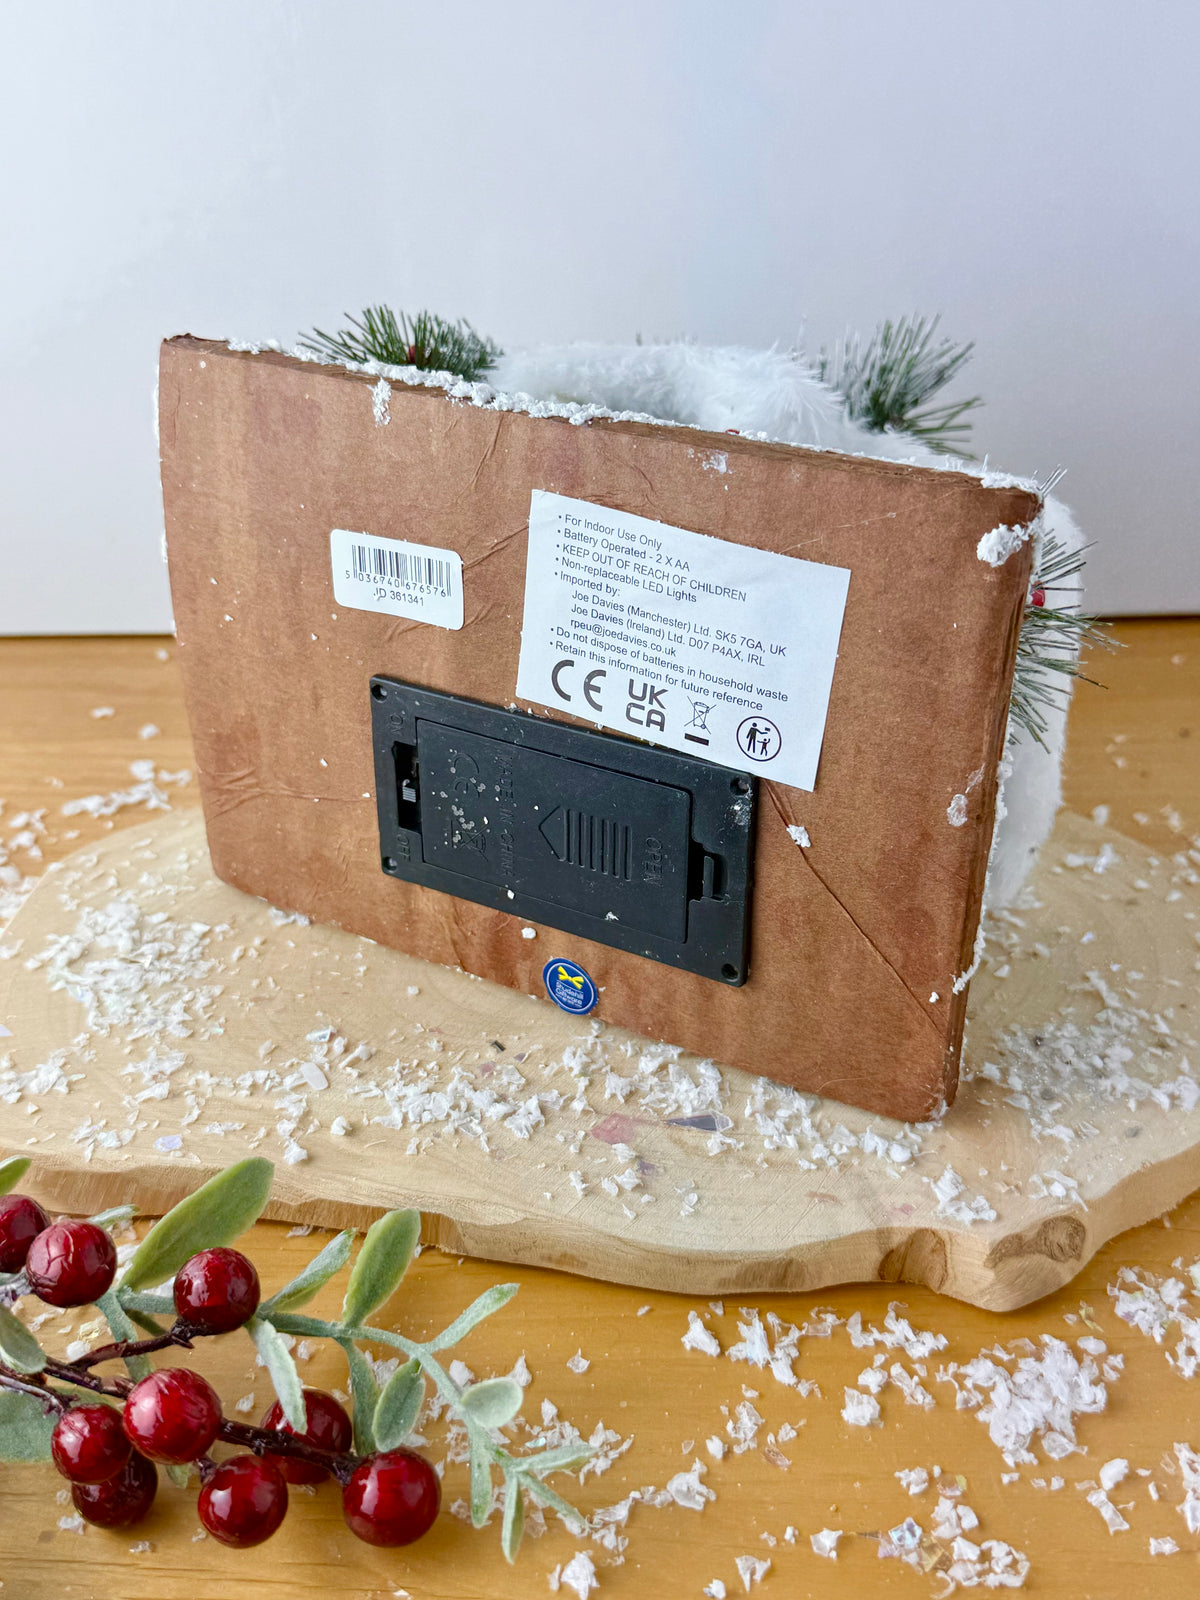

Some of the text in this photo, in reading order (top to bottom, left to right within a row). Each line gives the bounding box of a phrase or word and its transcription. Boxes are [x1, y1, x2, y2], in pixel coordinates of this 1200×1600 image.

[564, 528, 598, 549] Battery
[601, 538, 646, 559] Operated
[655, 553, 663, 564] 2
[664, 556, 673, 566] X
[674, 558, 690, 572] AA
[565, 514, 662, 550] For Indoor Use Only
[405, 582, 447, 598] 676576
[560, 570, 621, 597] Imported by:
[561, 557, 697, 603] Non-replaceable LED Lights
[562, 543, 747, 602] KEEP OUT OF REACH OF CHILDREN
[390, 591, 424, 606] 361341
[570, 618, 677, 657] rpeu@joedavies.co.uk
[571, 603, 766, 667] Joe Davies (Ireland) Ltd. D07 P4AX, IRL
[572, 589, 787, 657] Joe Davies (Manchester) Ltd. SK5 7GA, UK
[551, 659, 607, 712] CE
[555, 641, 763, 711] Retain this information for future reference
[556, 626, 789, 702] Do not dispose of batteries in household waste
[628, 678, 669, 710] UK
[625, 703, 666, 732] CA
[498, 753, 515, 878] MADE IN CHINA
[644, 836, 663, 886] OPEN
